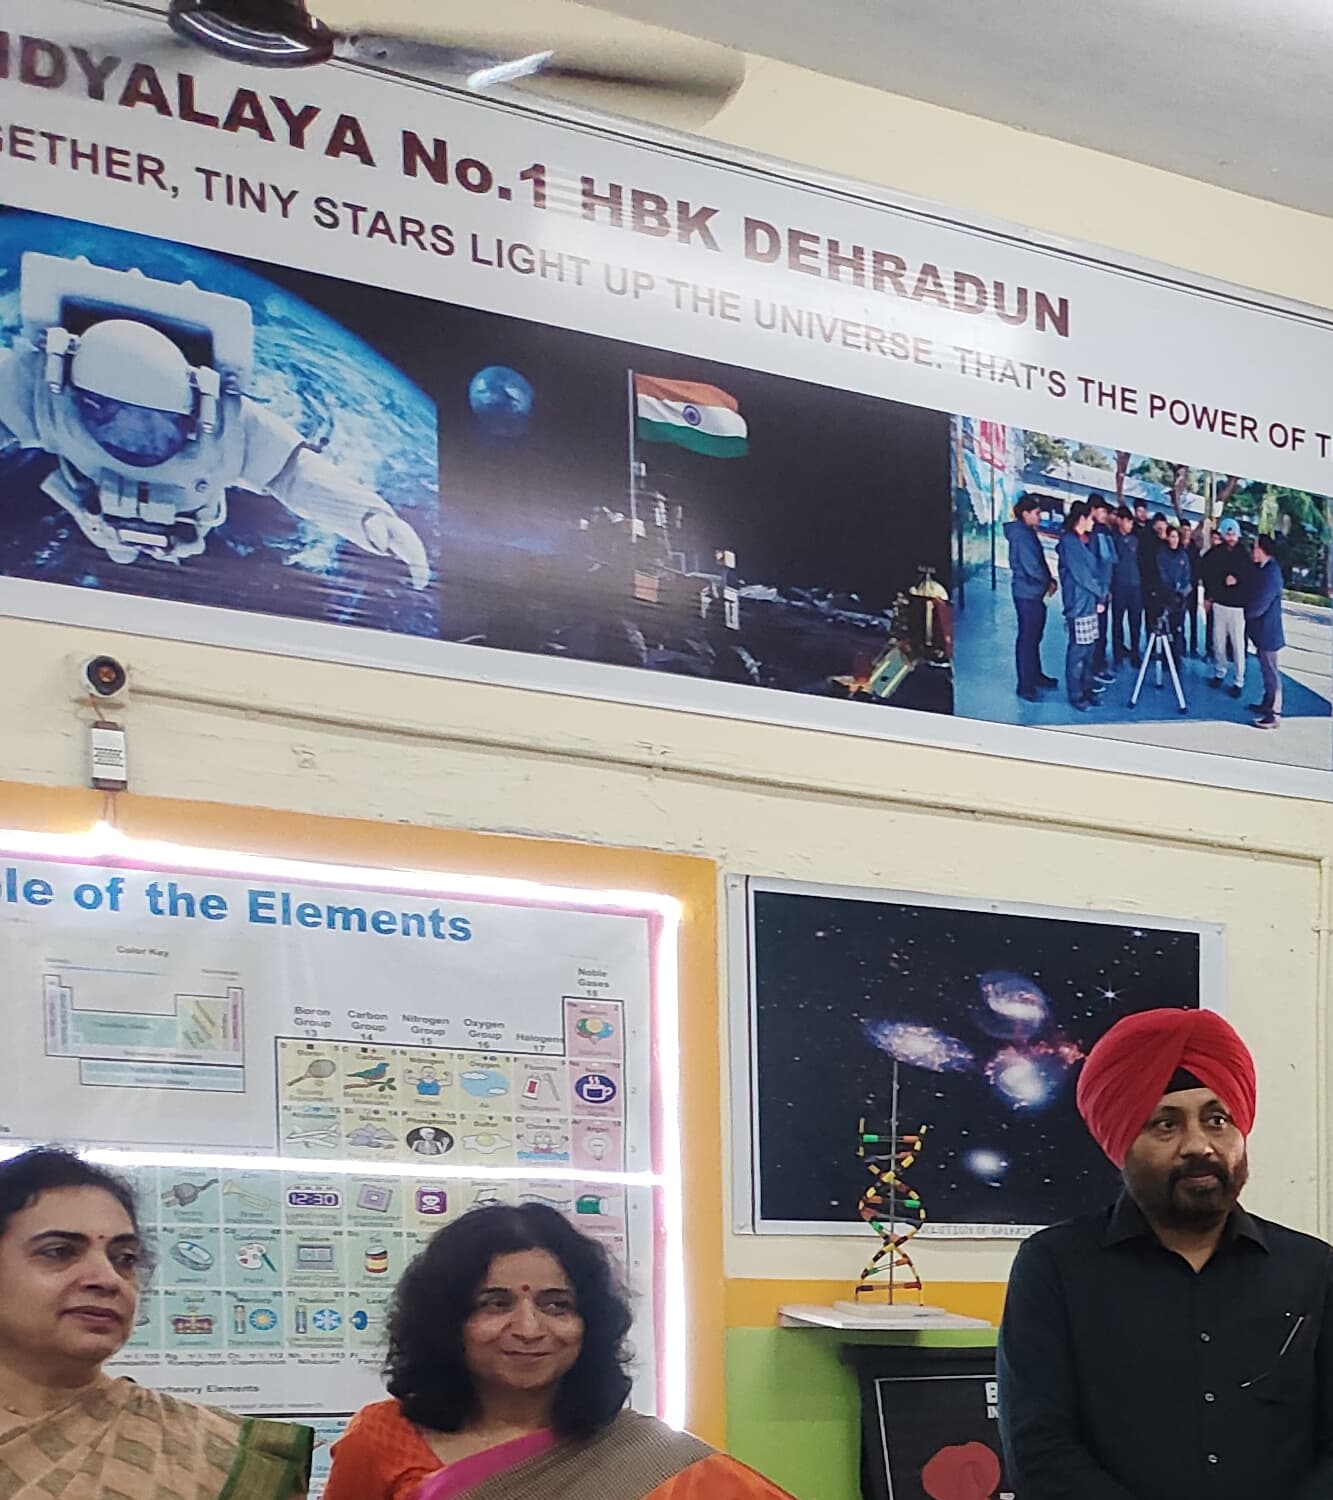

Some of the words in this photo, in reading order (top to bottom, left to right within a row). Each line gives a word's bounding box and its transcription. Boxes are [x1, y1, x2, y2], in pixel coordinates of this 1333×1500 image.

[401, 131, 548, 211] No.1
[581, 176, 721, 252] HBK
[744, 217, 1070, 338] DEHRADUN
[0, 124, 181, 198] ETHER,
[195, 167, 298, 220] TINY
[314, 197, 456, 257] STARS
[471, 233, 591, 287] LIGHT
[605, 267, 657, 301] UP
[665, 280, 741, 322] THE
[754, 301, 943, 371] UNIVERSE.
[954, 347, 1067, 398] THAT'S
[1078, 376, 1138, 416] THE
[1150, 393, 1258, 444] POWER
[1269, 420, 1307, 452] OF
[0, 868, 53, 905] le
[74, 877, 125, 912] of
[145, 881, 228, 923] the
[247, 889, 473, 943] Elements
[347, 1010, 389, 1021] Carbon
[402, 1013, 450, 1026] Nitrogen
[293, 1017, 332, 1029] Group
[351, 1021, 387, 1033] Group
[463, 1018, 505, 1030] Oxygen
[361, 1033, 374, 1041] 14
[410, 1025, 446, 1037] Group
[468, 1029, 503, 1041] Group
[420, 1037, 433, 1045] 15
[515, 1033, 565, 1044] Halogens
[289, 1192, 339, 1208] 12:30
[206, 1384, 260, 1394] Elements
